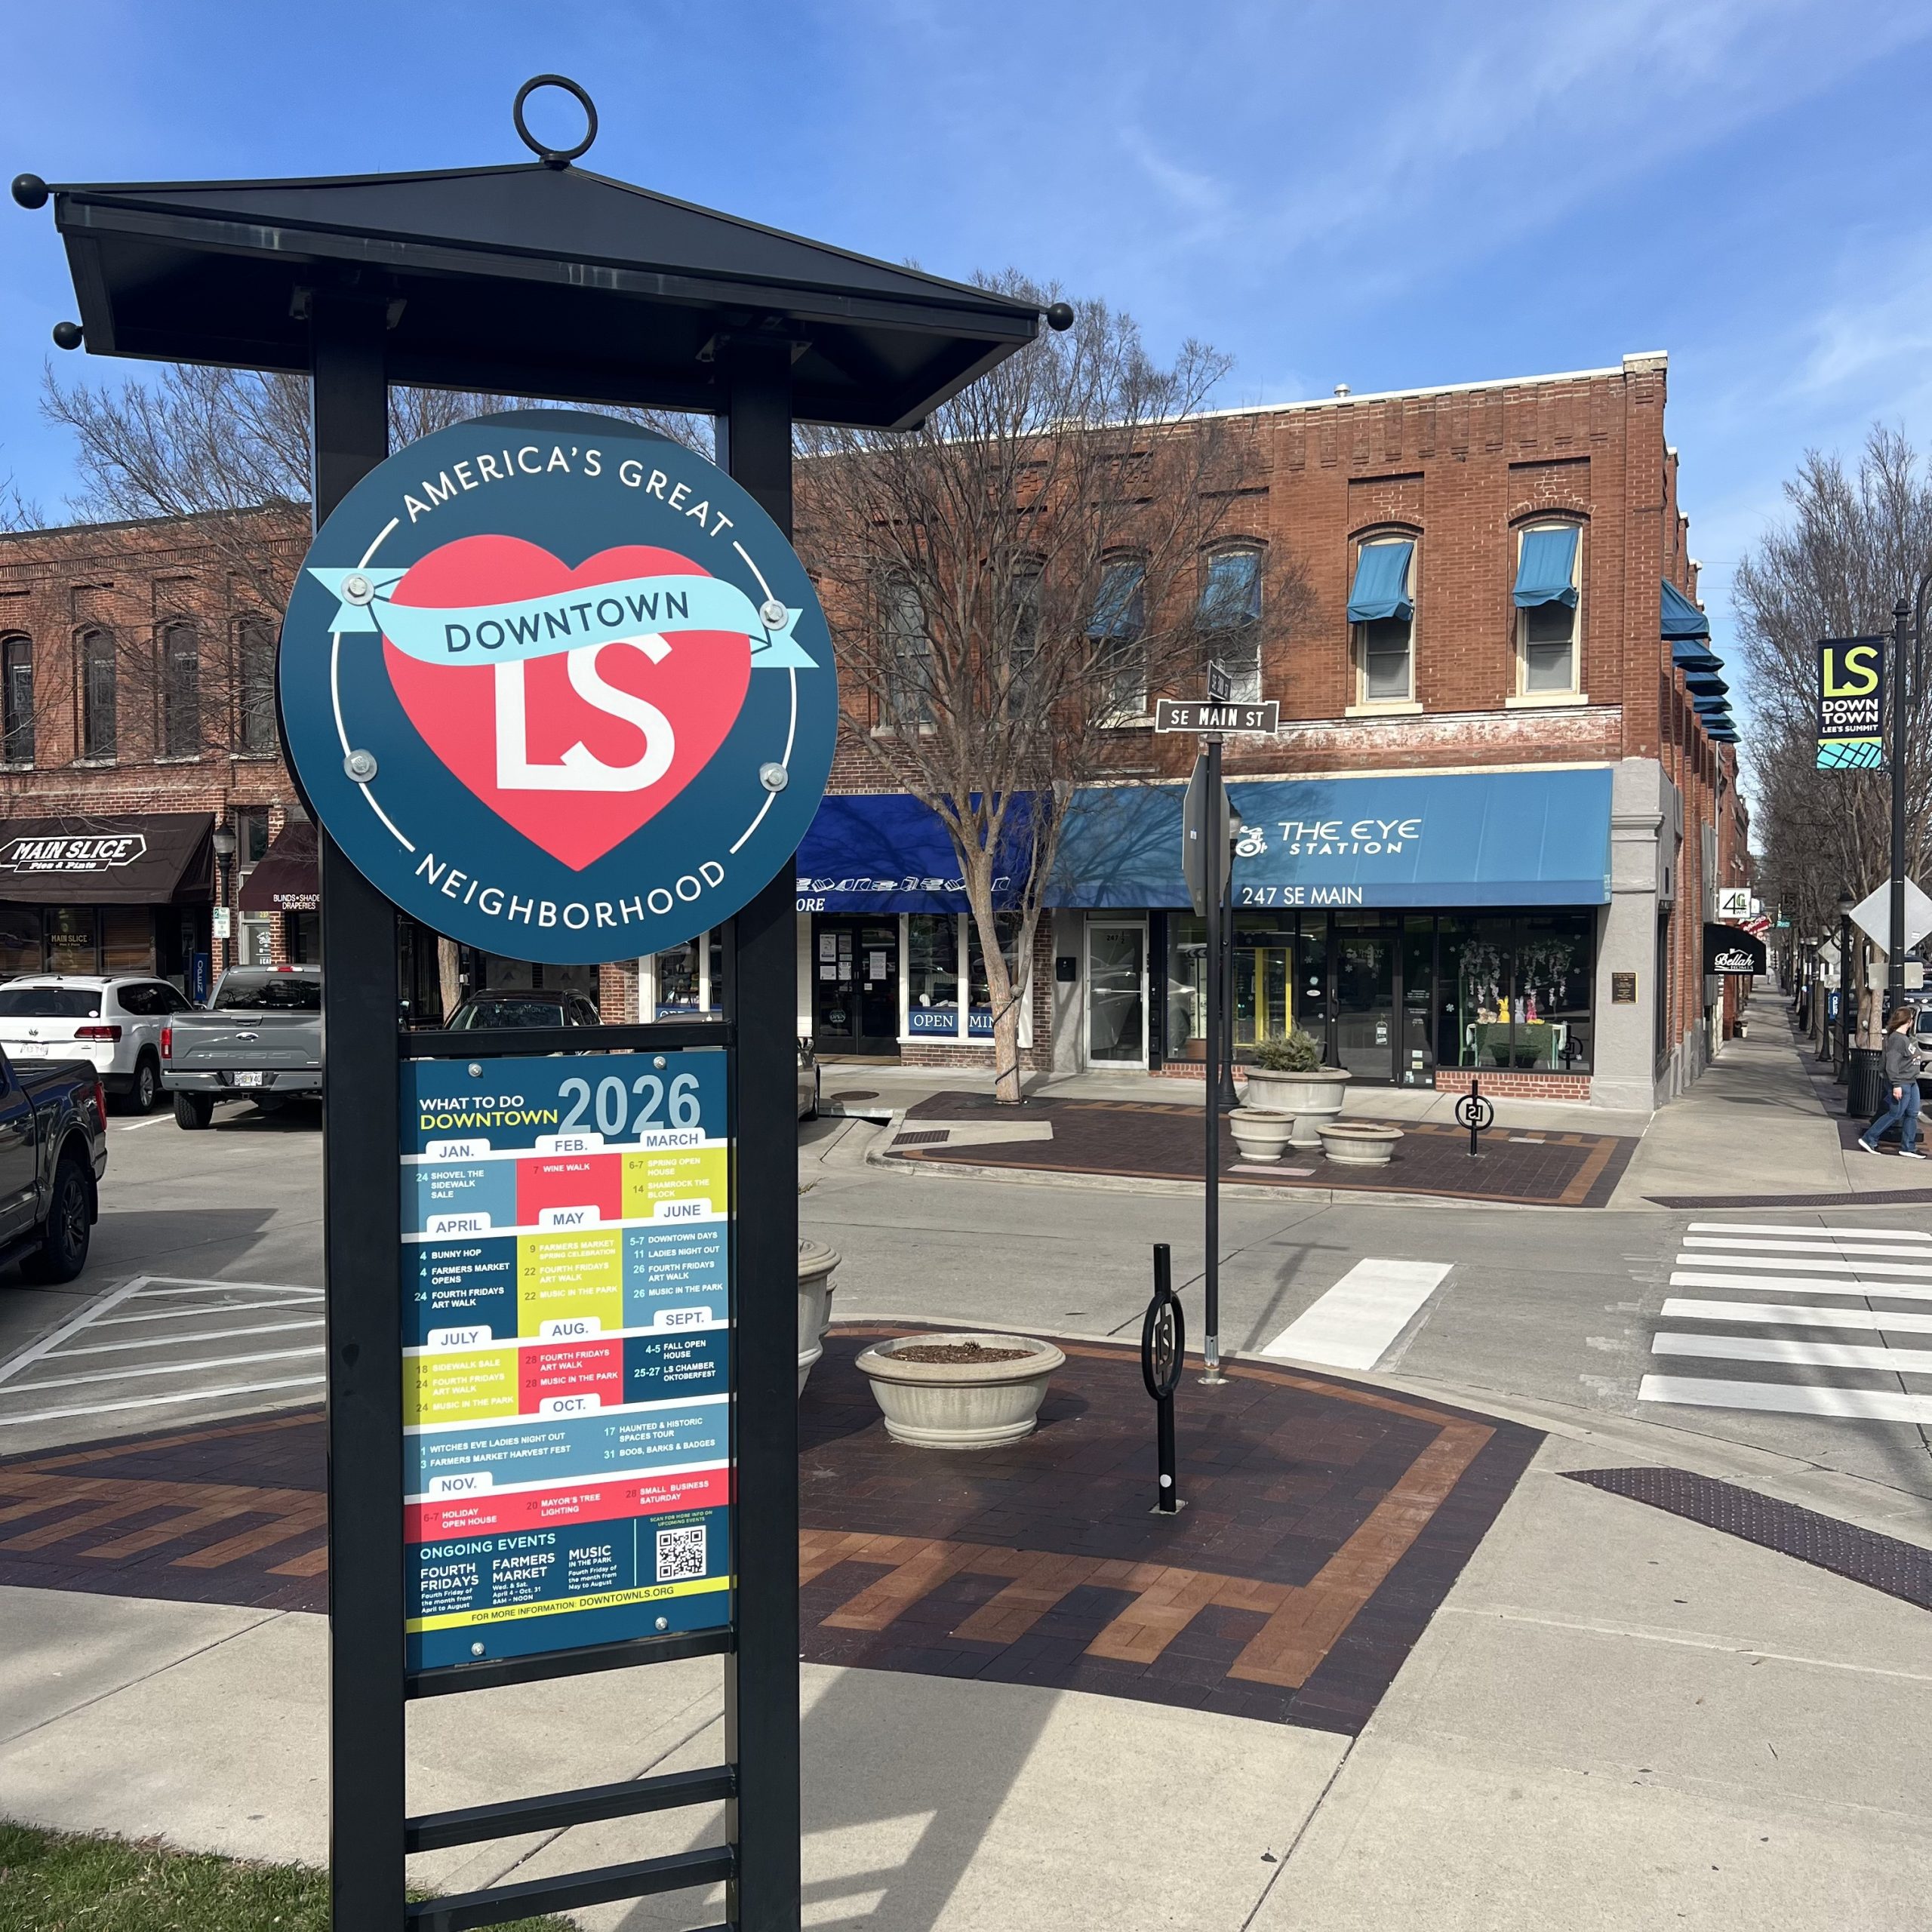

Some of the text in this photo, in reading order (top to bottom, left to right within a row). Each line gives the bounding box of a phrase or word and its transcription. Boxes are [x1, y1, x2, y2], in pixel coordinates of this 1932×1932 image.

[402, 445, 734, 537] AMERICA'S GREAT
[446, 591, 688, 653] DOWNTOWN
[1823, 646, 1878, 697] LS
[1822, 698, 1878, 712] DOWN
[494, 632, 675, 792] LS
[1171, 708, 1264, 727] SE MAIN ST
[1822, 711, 1878, 724] TOWN
[1278, 819, 1422, 841] THE EYE
[11, 839, 133, 860] MAIN SLICE
[1289, 841, 1402, 855] STATION
[415, 854, 725, 930] NEIGHBORHOOD
[1242, 887, 1362, 904] 247 SE MAIN
[796, 898, 825, 912] ORE
[1715, 953, 1755, 966] Bellah
[914, 1014, 953, 1027] OPEN
[420, 1096, 524, 1110] WHAT TO DO
[558, 1073, 700, 1136] 2026
[421, 1109, 558, 1130] DOWNTOWN
[555, 1140, 588, 1152] FEB.
[647, 1134, 698, 1146] MARCH
[439, 1146, 474, 1158] JAN.
[566, 1163, 590, 1171] WALK
[629, 1161, 644, 1169] 6-7
[648, 1158, 677, 1167] SPRING
[416, 1173, 428, 1182] 24
[431, 1171, 466, 1180] SHOVEL
[431, 1180, 475, 1189] SIDEWALK
[664, 1205, 700, 1217] JUNE
[553, 1213, 584, 1225] MAY
[435, 1220, 482, 1232] APRIL
[629, 1237, 645, 1245] 5-7
[648, 1233, 696, 1243] DOWNTOWN
[420, 1251, 426, 1260] 4
[432, 1251, 461, 1259] BUNNY
[634, 1250, 644, 1259] 11
[648, 1249, 676, 1258] LADIES
[678, 1247, 702, 1255] NIGHT
[420, 1263, 510, 1276] 4 FARMERS MARKET
[633, 1261, 715, 1273] 26 FOURTH FRIDAYS
[432, 1276, 461, 1284] OPENS
[414, 1287, 504, 1301] 24 FOURTH FRIDAYS
[432, 1299, 476, 1309] ART WALK
[666, 1312, 704, 1325] SEPT.
[552, 1323, 588, 1336] AUG.
[441, 1331, 478, 1345] JULY
[645, 1340, 706, 1353] 4-5 FALL OPEN
[663, 1350, 691, 1359] HOUSE
[634, 1367, 660, 1377] 25-27
[675, 1361, 715, 1371] CHAMBER
[663, 1370, 715, 1381] OKTOBERFEST
[553, 1398, 586, 1412] OCT.
[604, 1427, 615, 1436] 17
[620, 1423, 657, 1433] HAUNTED
[666, 1418, 703, 1427] HISTORIC
[430, 1443, 468, 1454] WITCHES
[471, 1441, 487, 1449] EVE
[489, 1437, 519, 1447] LADIES
[521, 1435, 546, 1444] NIGHT
[548, 1432, 565, 1441] OUT
[620, 1433, 651, 1442] SPACES
[604, 1450, 614, 1459] 31
[620, 1447, 645, 1457] BOOS,
[646, 1443, 674, 1454] BARKS
[683, 1439, 715, 1449] BADGES
[420, 1445, 571, 1469] 3 FARMERS MARKET HARVEST FEST
[441, 1478, 477, 1491] NOV.
[640, 1481, 709, 1495] SMALL BUSINESS
[541, 1494, 601, 1507] MAYOR'S TREE
[640, 1493, 681, 1504] SATURDAY
[442, 1508, 478, 1518] HOLIDAY
[541, 1506, 579, 1516] LIGHTING
[442, 1515, 497, 1528] OPEN HOUSE
[420, 1533, 555, 1560] ONGOING EVENTS
[569, 1545, 611, 1561] MUSIC
[493, 1553, 555, 1570] FARMERS
[420, 1563, 475, 1578] FOURTH
[493, 1567, 547, 1583] MARKET
[420, 1575, 479, 1591] FRIDAYS
[472, 1613, 488, 1621] FOR
[491, 1610, 515, 1618] MORE
[580, 1586, 674, 1607] DOWNTOWNLS.ORG
